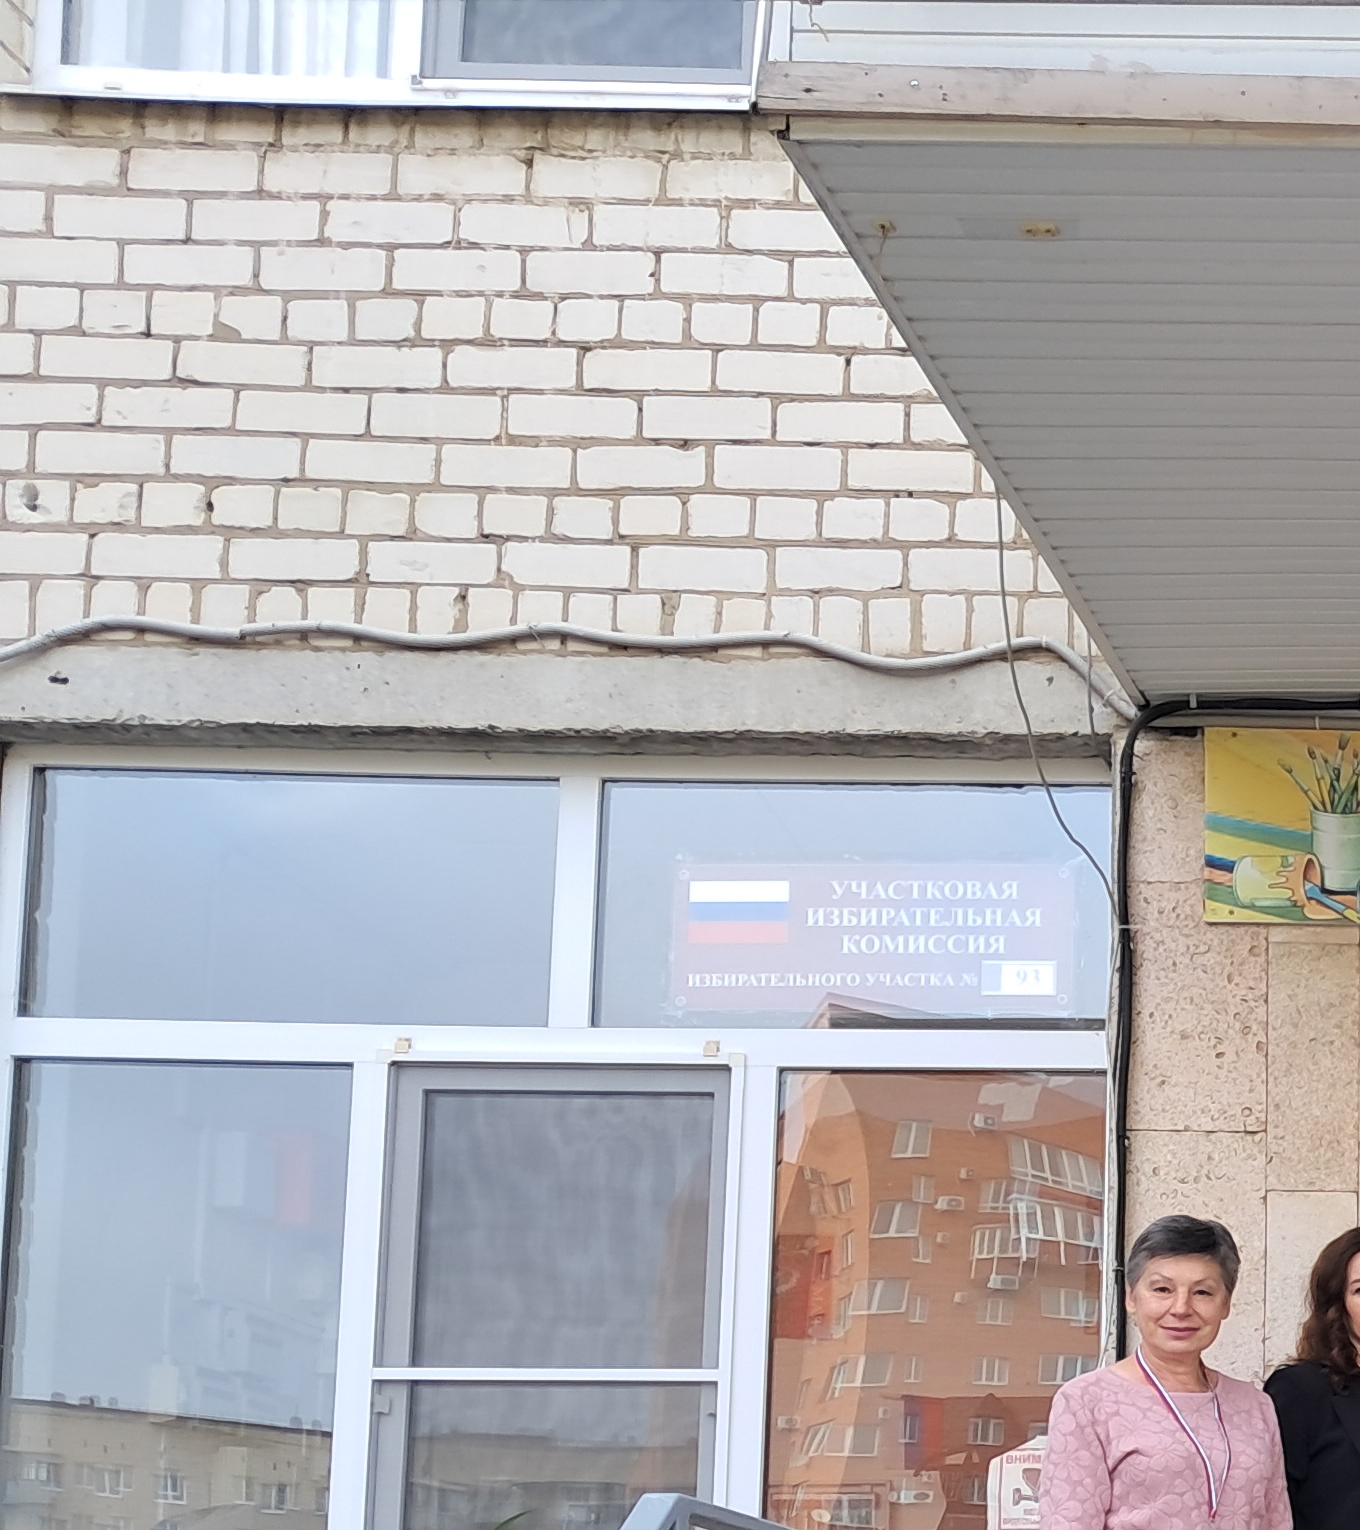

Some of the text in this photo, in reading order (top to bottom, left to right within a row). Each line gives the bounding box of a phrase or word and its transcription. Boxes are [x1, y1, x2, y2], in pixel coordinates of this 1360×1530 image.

[829, 880, 1019, 900] УЧАСТКОВАЯ
[805, 907, 1043, 928] ИЗБИРАТЕЛЬНАЯ
[840, 934, 1007, 955] КОМИССИЯ
[687, 972, 861, 988] ИЗБИРАТЕЛЬНОГО
[864, 972, 955, 988] УЧАСТКА
